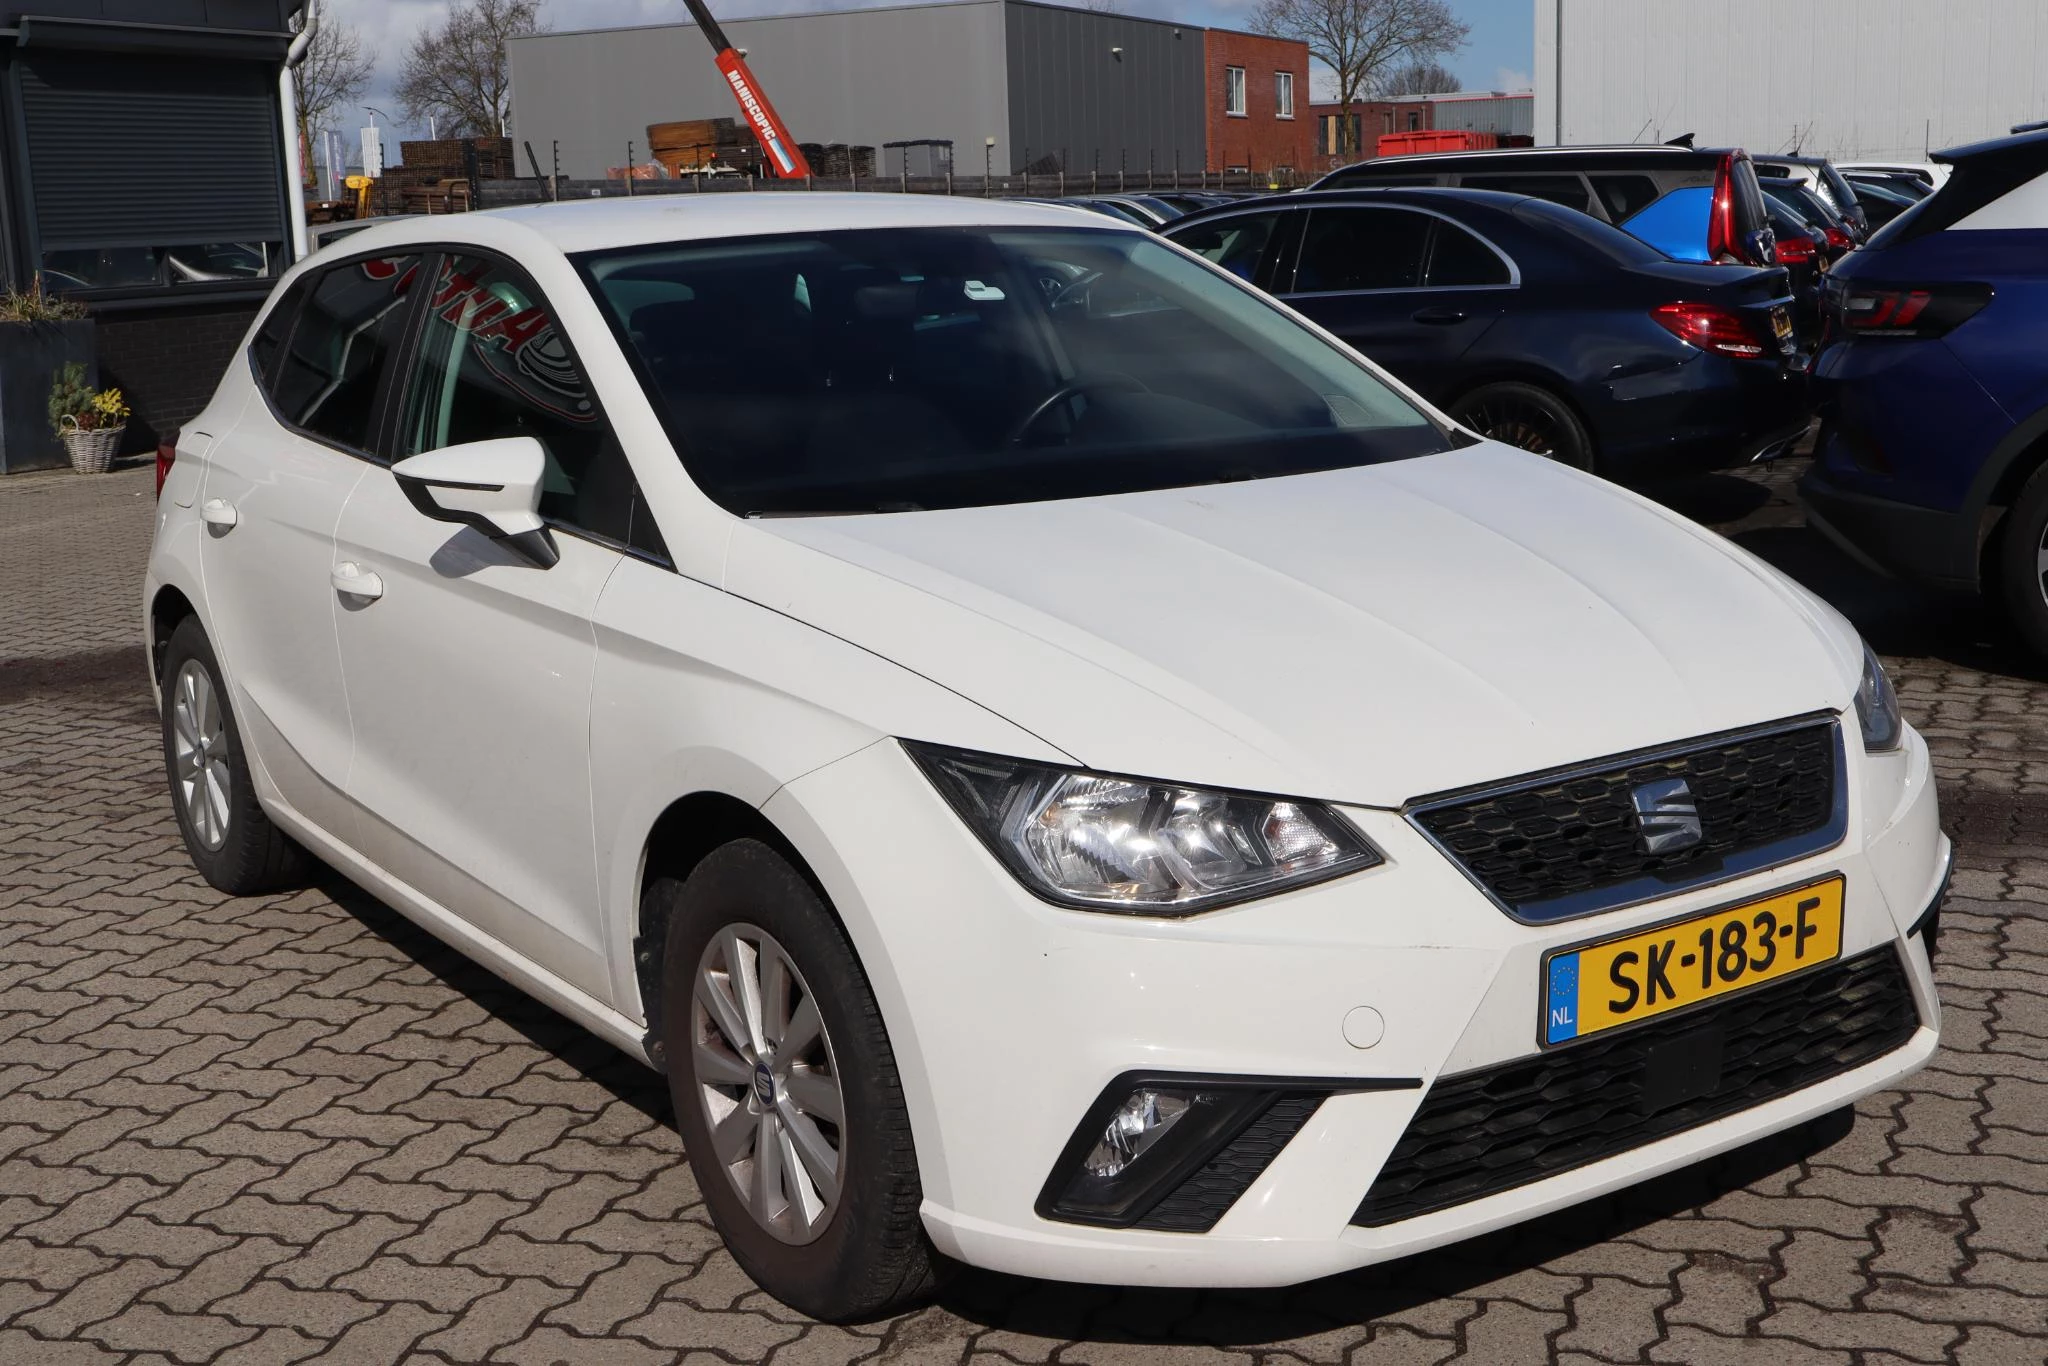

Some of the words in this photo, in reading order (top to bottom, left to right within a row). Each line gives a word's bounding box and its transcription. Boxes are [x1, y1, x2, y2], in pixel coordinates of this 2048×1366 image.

[727, 69, 777, 141] MANISCOPIC
[1608, 896, 1821, 1014] SK-183-F
[1551, 1006, 1573, 1028] NL
